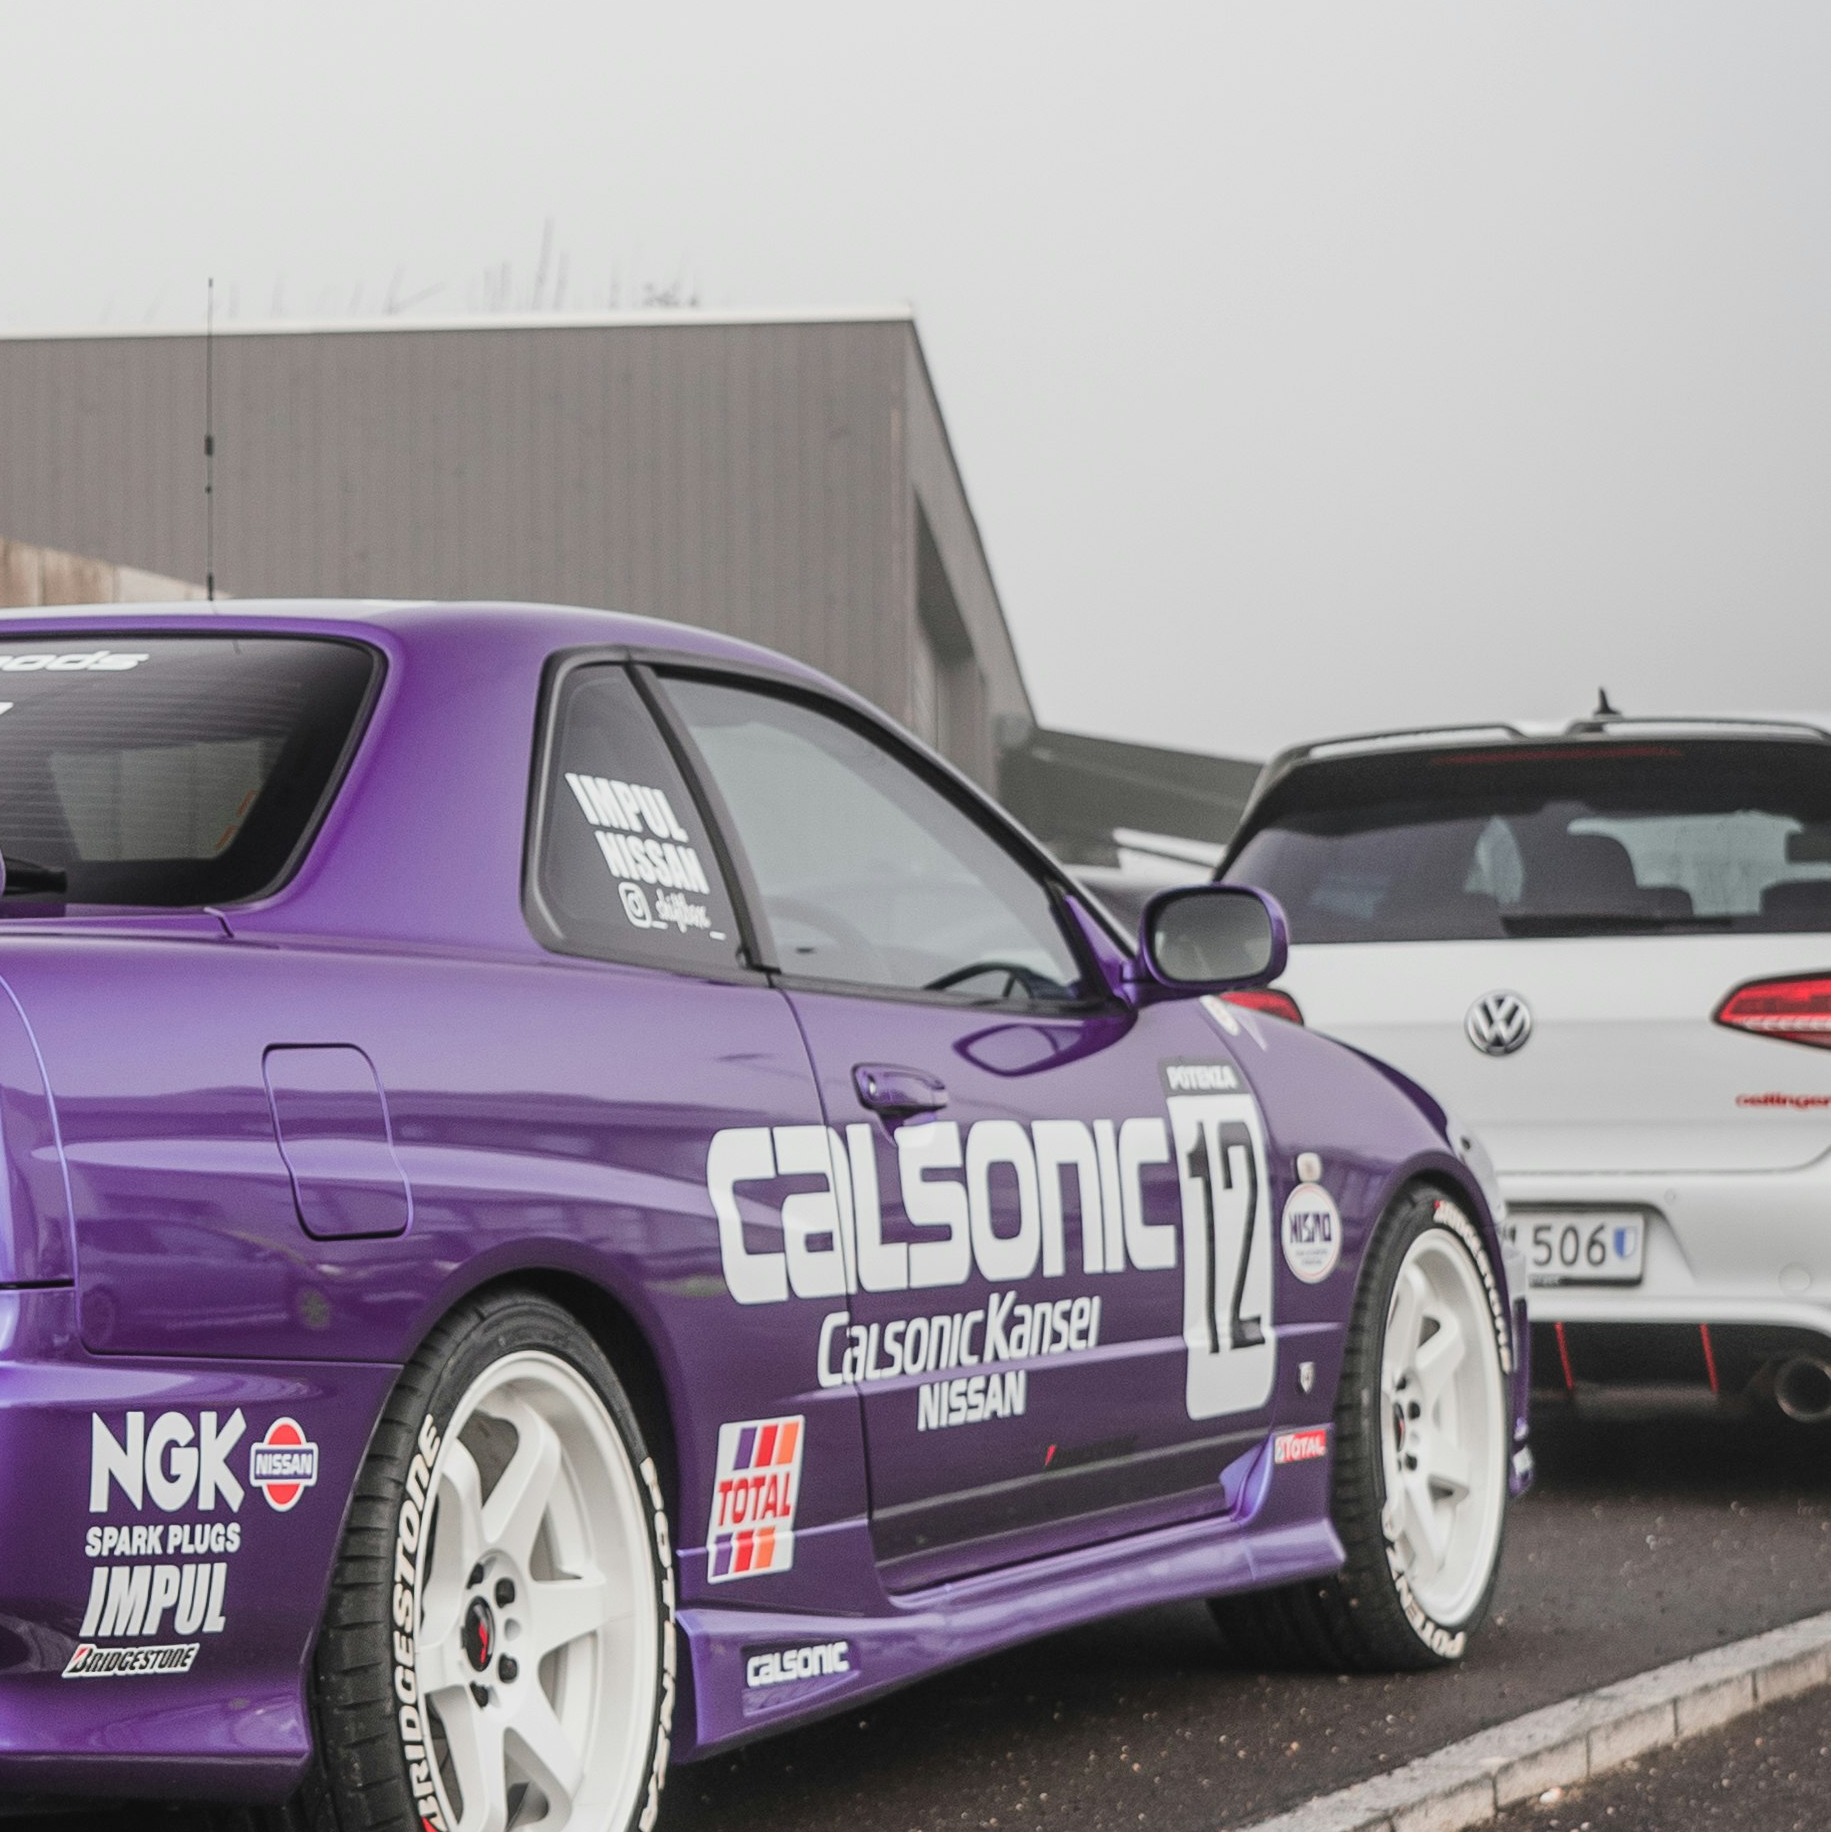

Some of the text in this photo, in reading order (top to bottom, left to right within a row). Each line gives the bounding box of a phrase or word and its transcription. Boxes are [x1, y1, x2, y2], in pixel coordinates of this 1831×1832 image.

[565, 773, 689, 843] IMPUL
[594, 830, 710, 895] NISSAN
[1167, 1064, 1237, 1090] POTENZA
[1186, 1120, 1266, 1355] 12
[1289, 1212, 1332, 1243] NISMO
[917, 1371, 1026, 1431] NISSAN
[89, 1407, 247, 1513] NGK
[256, 1453, 313, 1476] NISSAN
[717, 1472, 794, 1525] TOTAL
[85, 1522, 242, 1557] SPARK PLUGS
[79, 1562, 228, 1637] IMPUL
[68, 1644, 198, 1673] BRIDGESTONE
